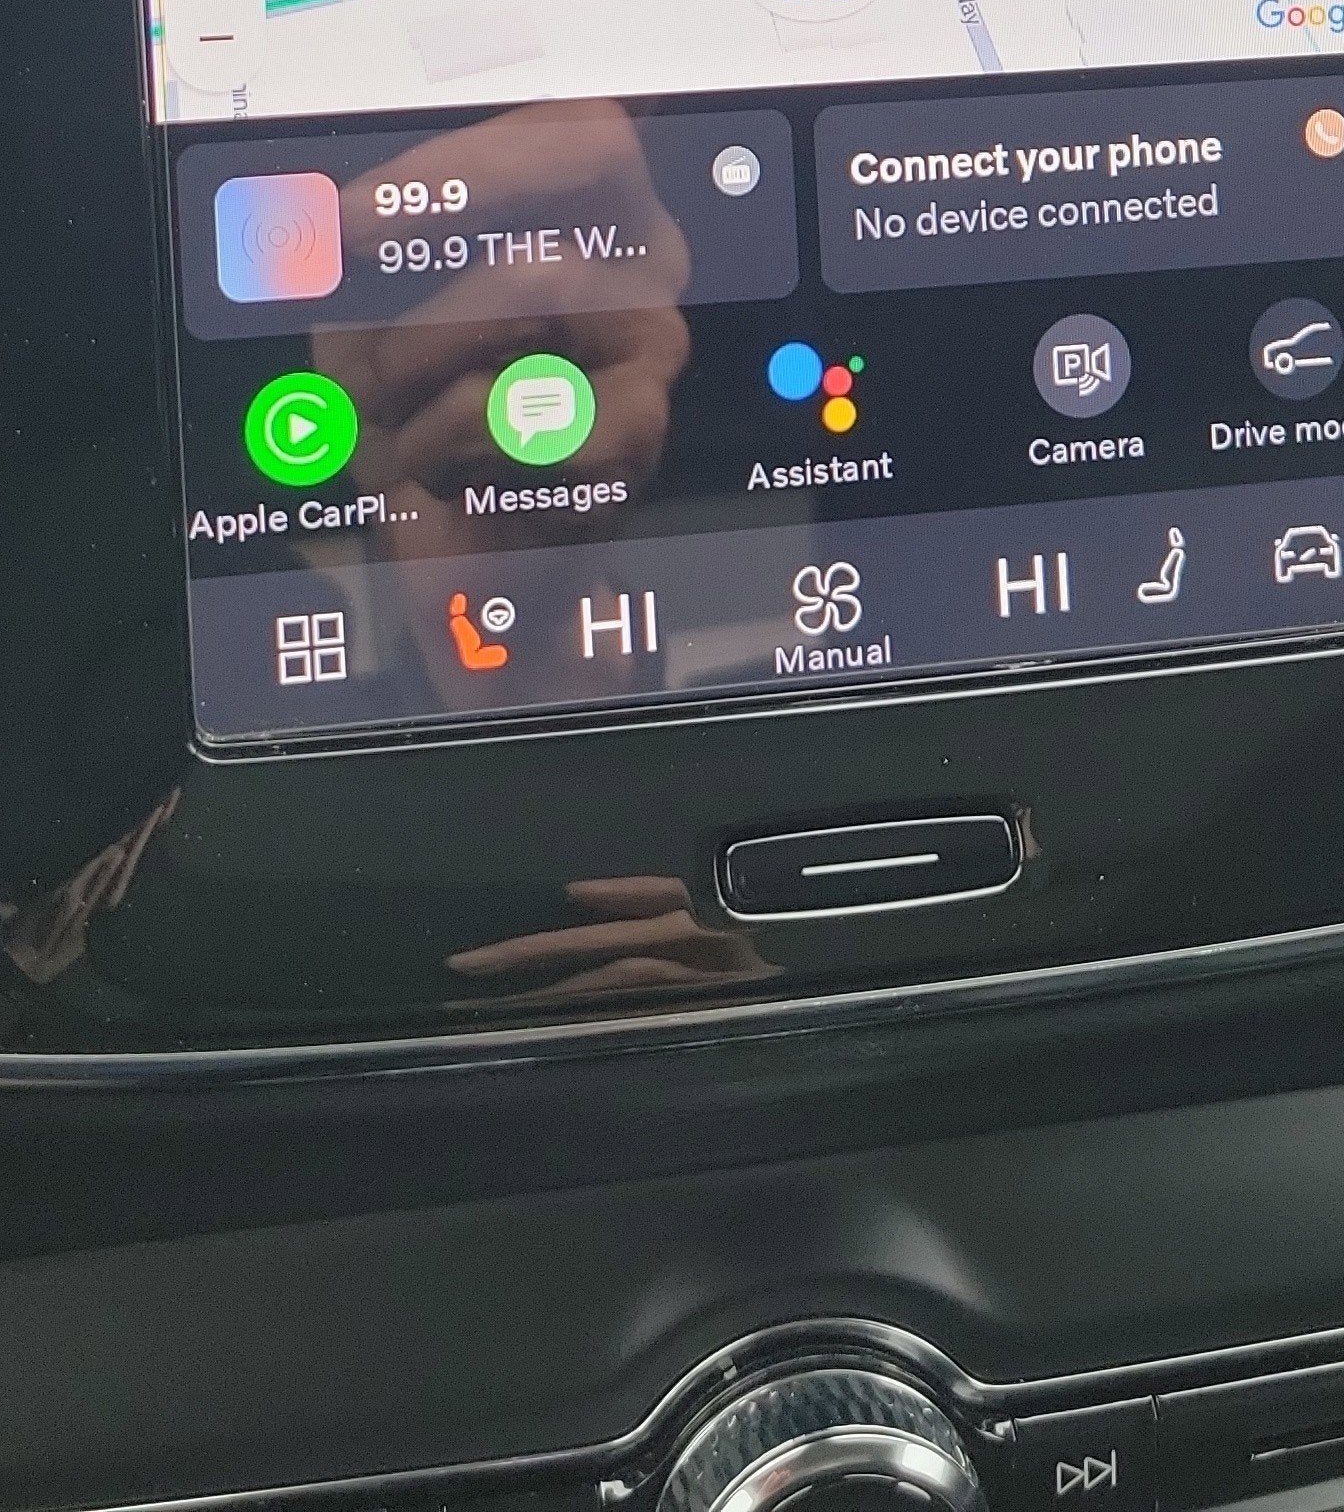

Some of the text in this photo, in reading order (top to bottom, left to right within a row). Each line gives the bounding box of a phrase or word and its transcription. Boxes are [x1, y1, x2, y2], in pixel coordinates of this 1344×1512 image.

[850, 132, 1222, 187] Connect your phone
[374, 178, 469, 218] 99.9
[855, 182, 1219, 242] No device connected
[378, 235, 469, 274] 99.9
[477, 230, 562, 268] THE
[1028, 433, 1145, 467] Camera
[1210, 414, 1287, 452] Drive
[746, 451, 894, 491] Assistant
[464, 476, 628, 517] Messages
[188, 504, 288, 544] Apple
[995, 551, 1071, 619] HI
[581, 590, 657, 659] HI
[774, 635, 892, 675] Manual
